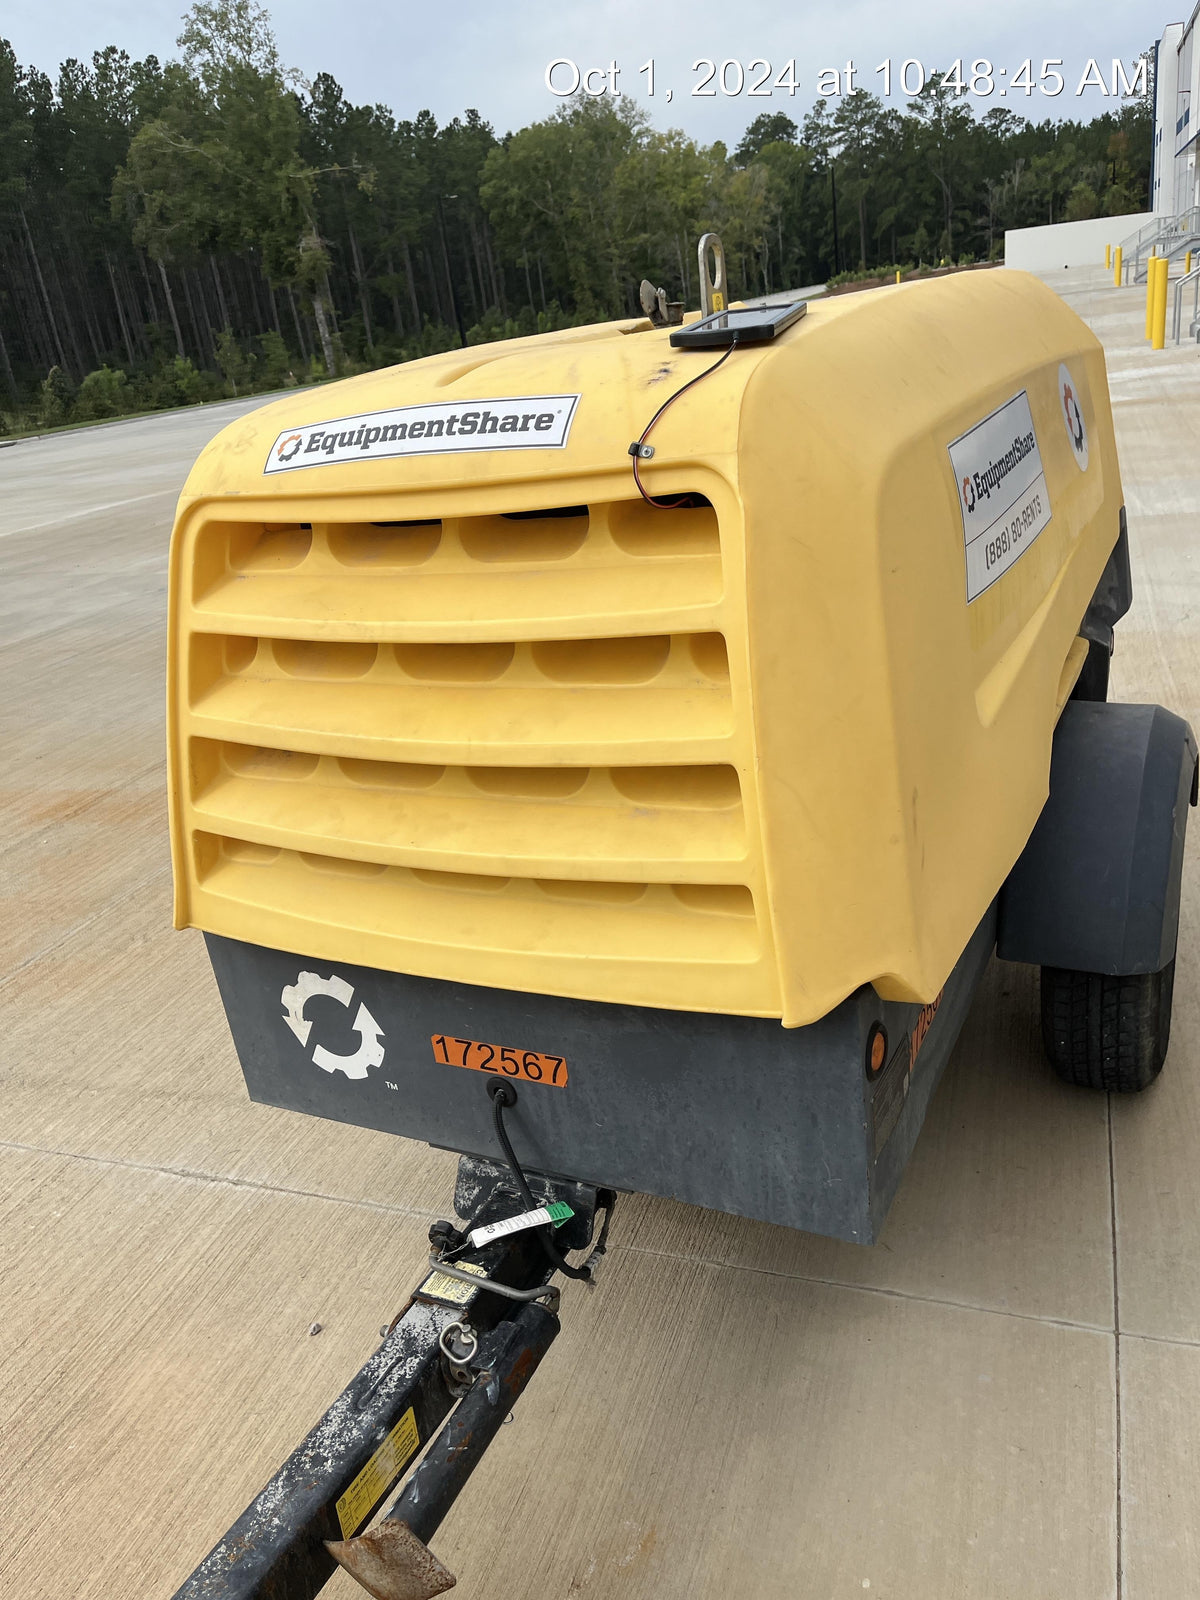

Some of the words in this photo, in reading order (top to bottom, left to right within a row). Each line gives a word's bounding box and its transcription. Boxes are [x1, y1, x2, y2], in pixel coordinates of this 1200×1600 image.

[304, 411, 554, 455] EquipmentShare
[972, 431, 1035, 500] EquipmentShare
[985, 526, 1011, 570] (888)
[1012, 496, 1042, 543] 80-RENTS
[435, 1035, 563, 1084] 172567
[385, 1080, 398, 1090] TM
